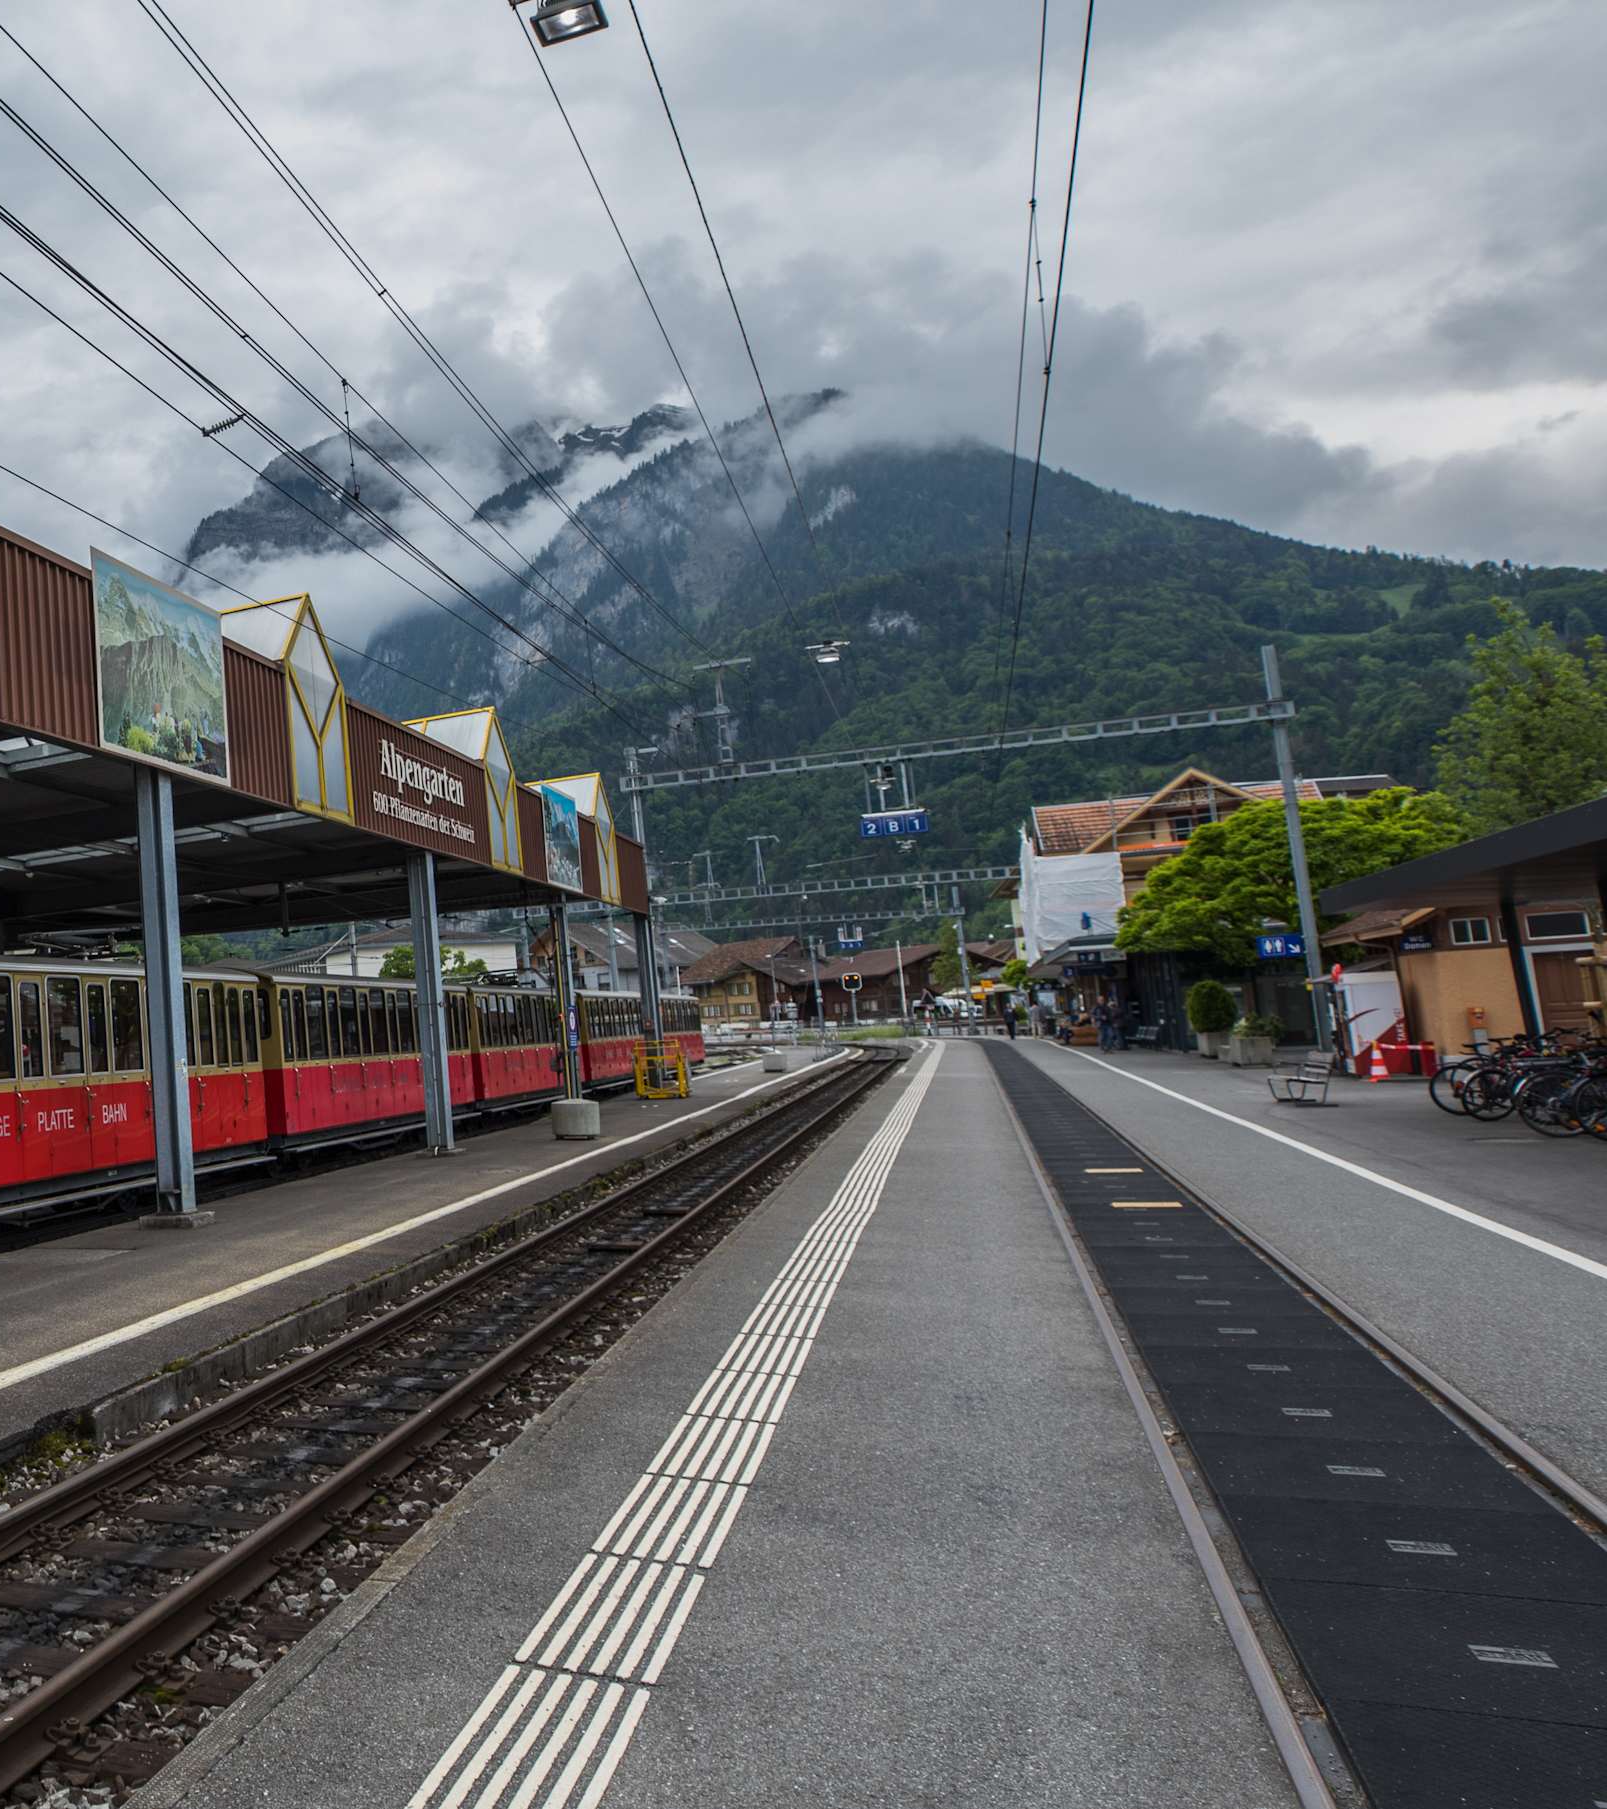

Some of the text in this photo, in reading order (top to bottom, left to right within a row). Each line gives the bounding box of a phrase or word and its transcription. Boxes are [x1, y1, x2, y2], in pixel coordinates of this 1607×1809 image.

[380, 738, 465, 807] Alpengarten
[373, 790, 389, 815] 600
[390, 797, 438, 831] Pflanzenarten
[439, 815, 450, 835] der
[867, 823, 876, 834] 2
[913, 819, 919, 830] 1
[38, 1108, 75, 1132] PLATTE
[102, 1103, 128, 1124] BAHN
